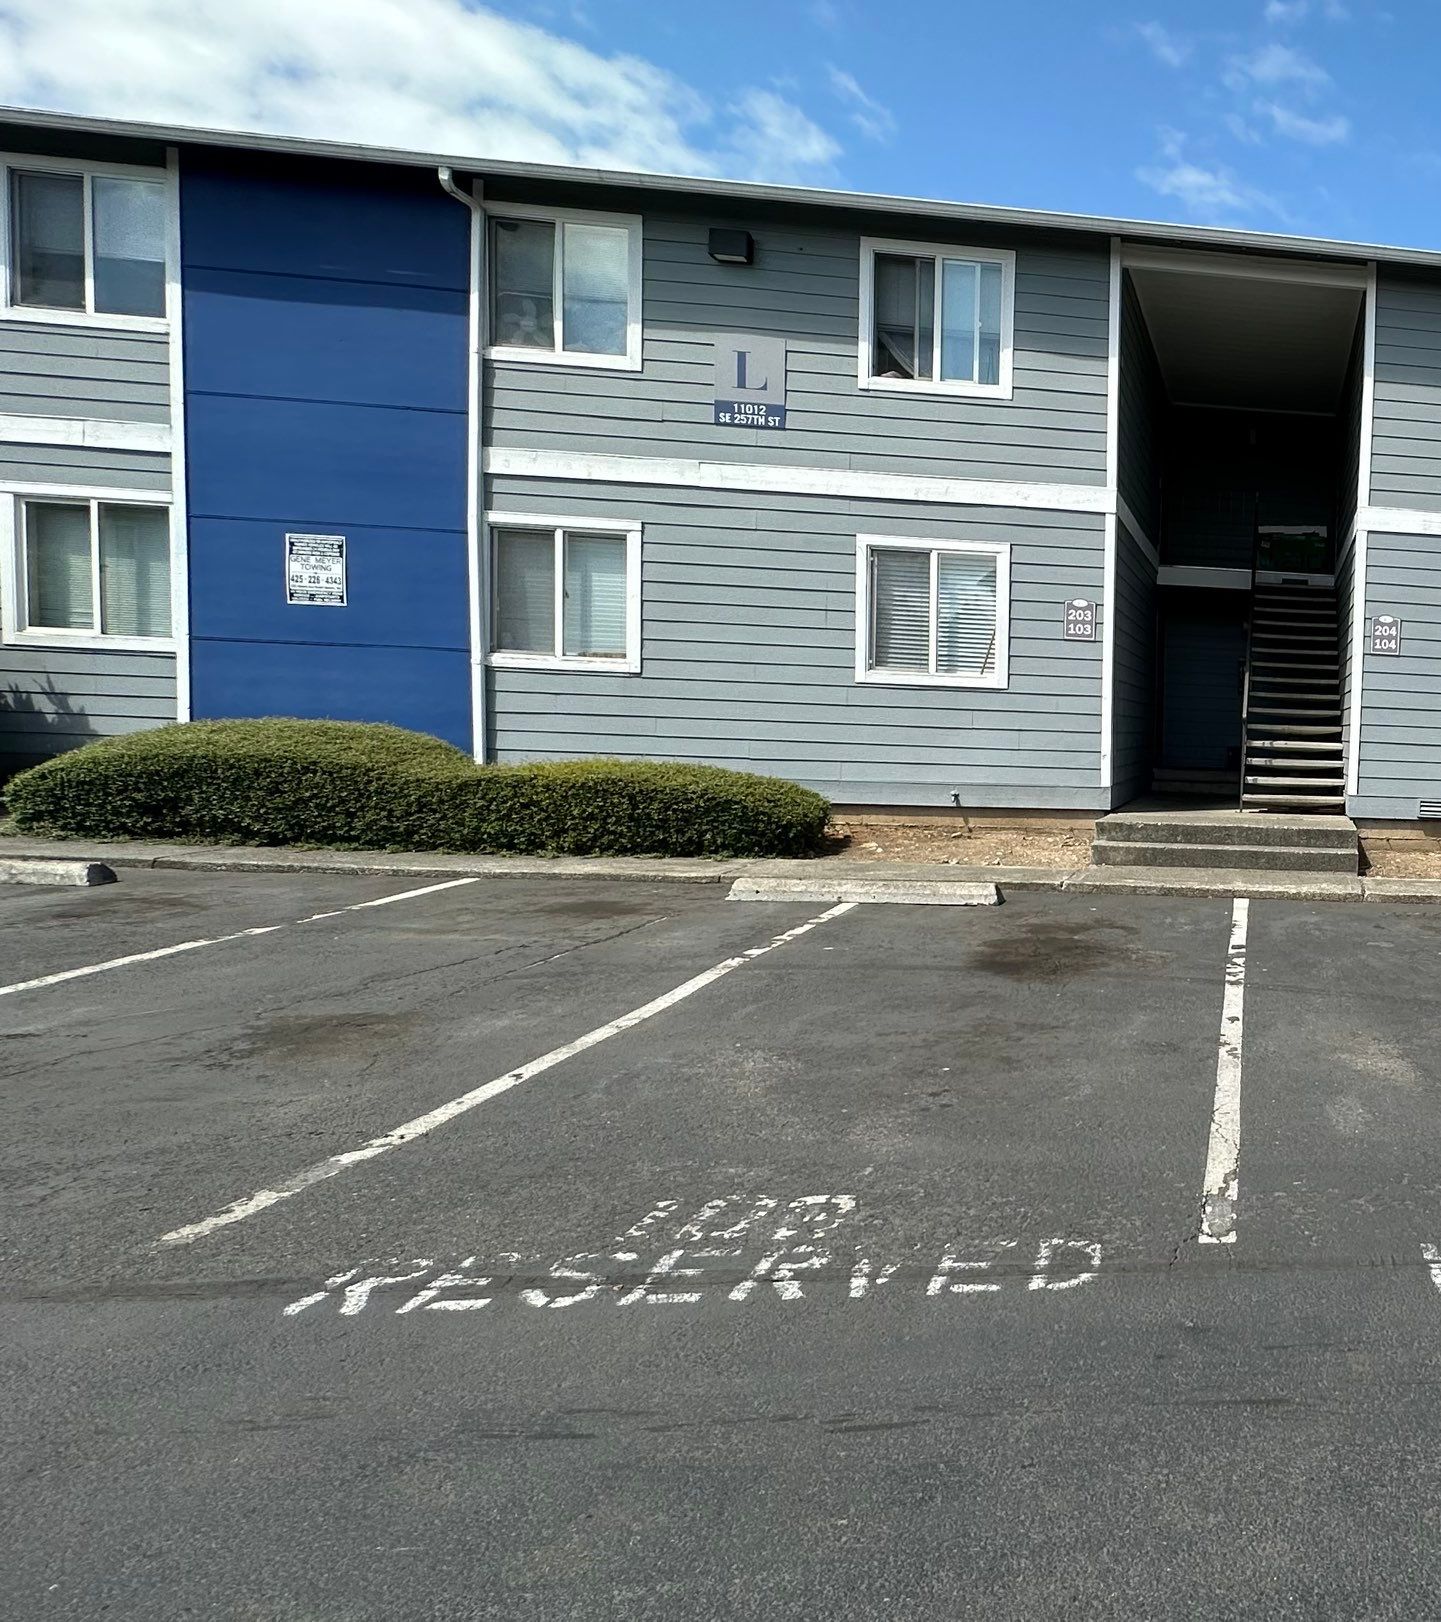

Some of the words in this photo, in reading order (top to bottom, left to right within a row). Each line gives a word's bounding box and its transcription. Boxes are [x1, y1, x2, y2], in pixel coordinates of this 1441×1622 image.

[731, 350, 768, 391] L
[733, 403, 767, 415] 11012
[719, 412, 732, 423] SE
[733, 413, 766, 426] 257TH
[767, 416, 781, 427] ST
[290, 555, 312, 563] GENE
[314, 557, 342, 565] MEYER
[300, 563, 333, 572] TOWING
[1067, 609, 1092, 621] 203
[1067, 623, 1092, 635] 103
[1374, 625, 1397, 637] 204
[1374, 638, 1397, 650] 104
[283, 1237, 1102, 1316] RESERVED
